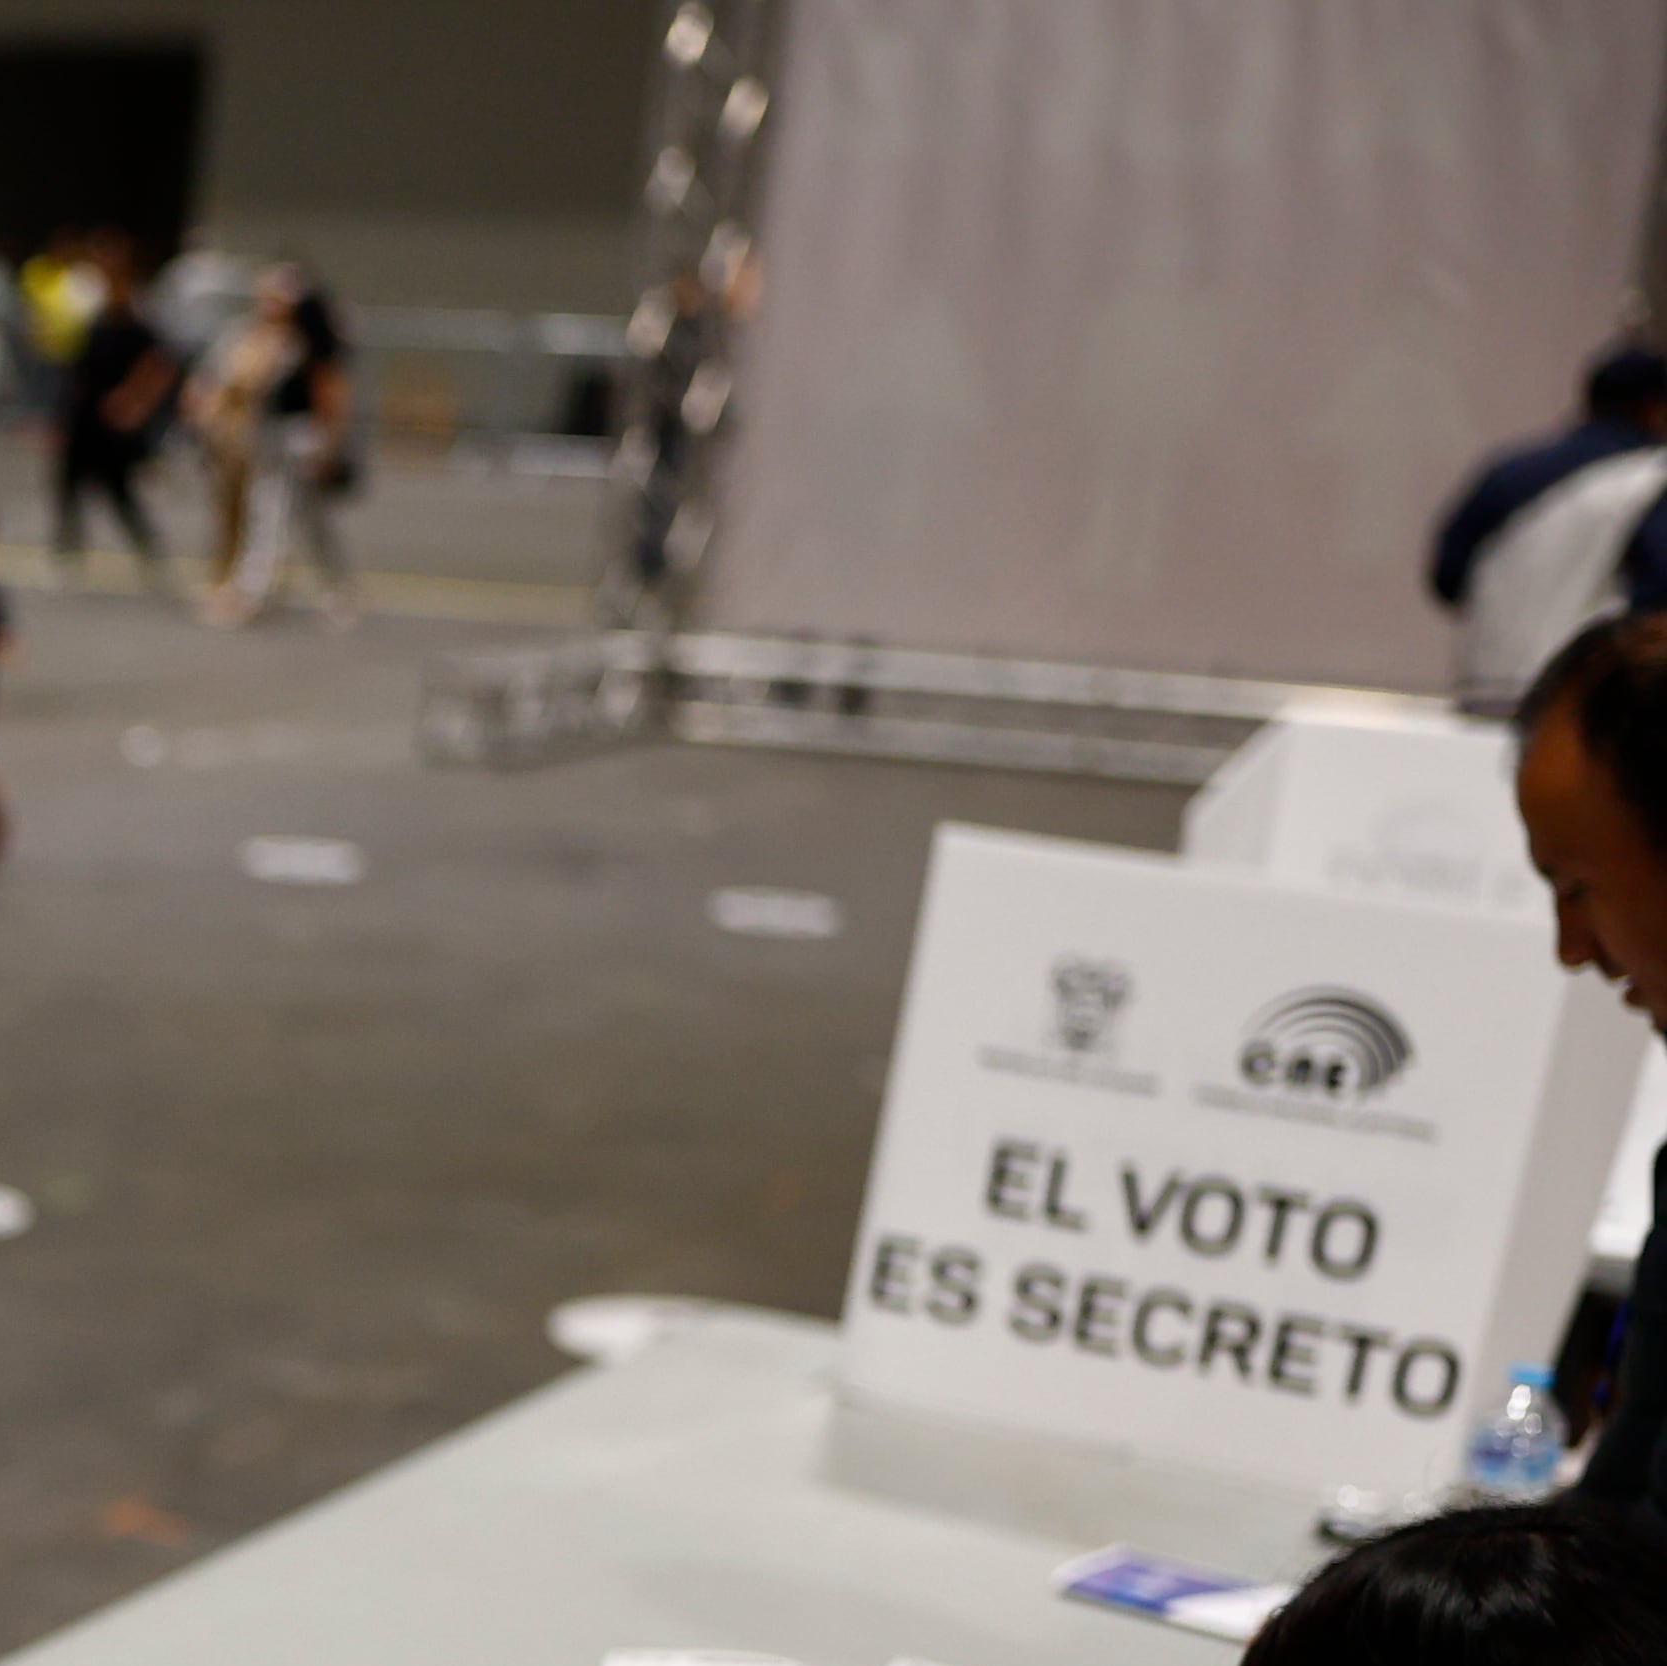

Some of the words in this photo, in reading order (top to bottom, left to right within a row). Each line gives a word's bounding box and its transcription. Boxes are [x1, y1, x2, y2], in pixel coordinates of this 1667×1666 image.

[984, 1135, 1089, 1235] EL
[1119, 1157, 1381, 1284] VOTO
[869, 1230, 983, 1330] ES
[1008, 1260, 1462, 1420] SECRETO
